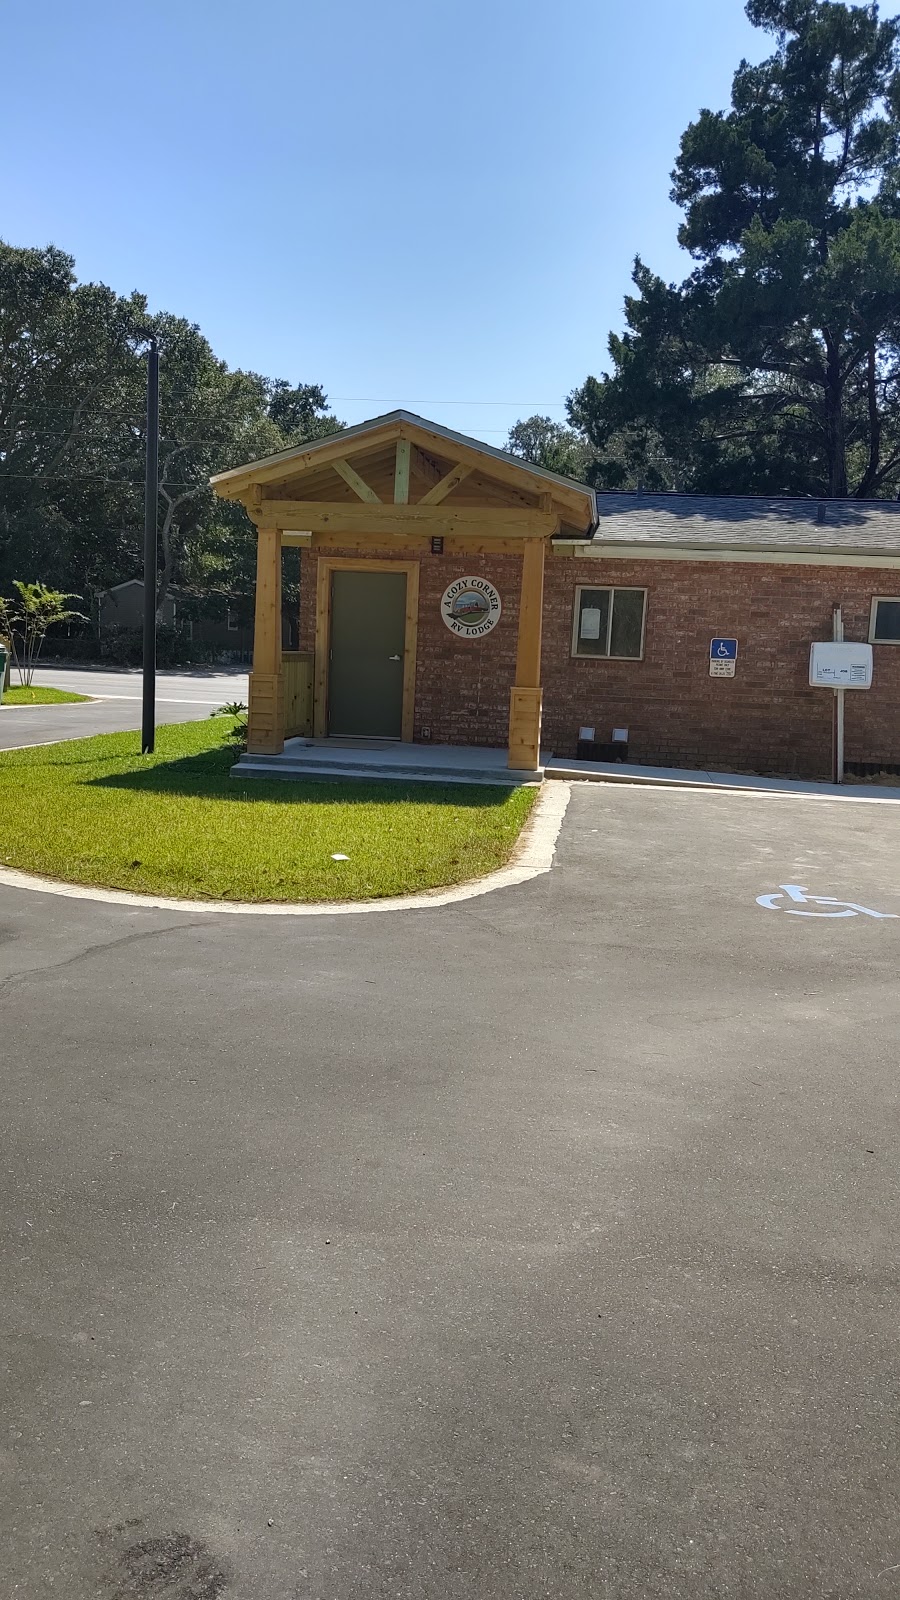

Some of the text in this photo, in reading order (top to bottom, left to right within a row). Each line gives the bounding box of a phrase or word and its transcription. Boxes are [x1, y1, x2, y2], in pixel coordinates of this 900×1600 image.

[446, 580, 468, 599] COZY
[471, 580, 498, 610] CORNER
[450, 618, 494, 636] RV LODGE
